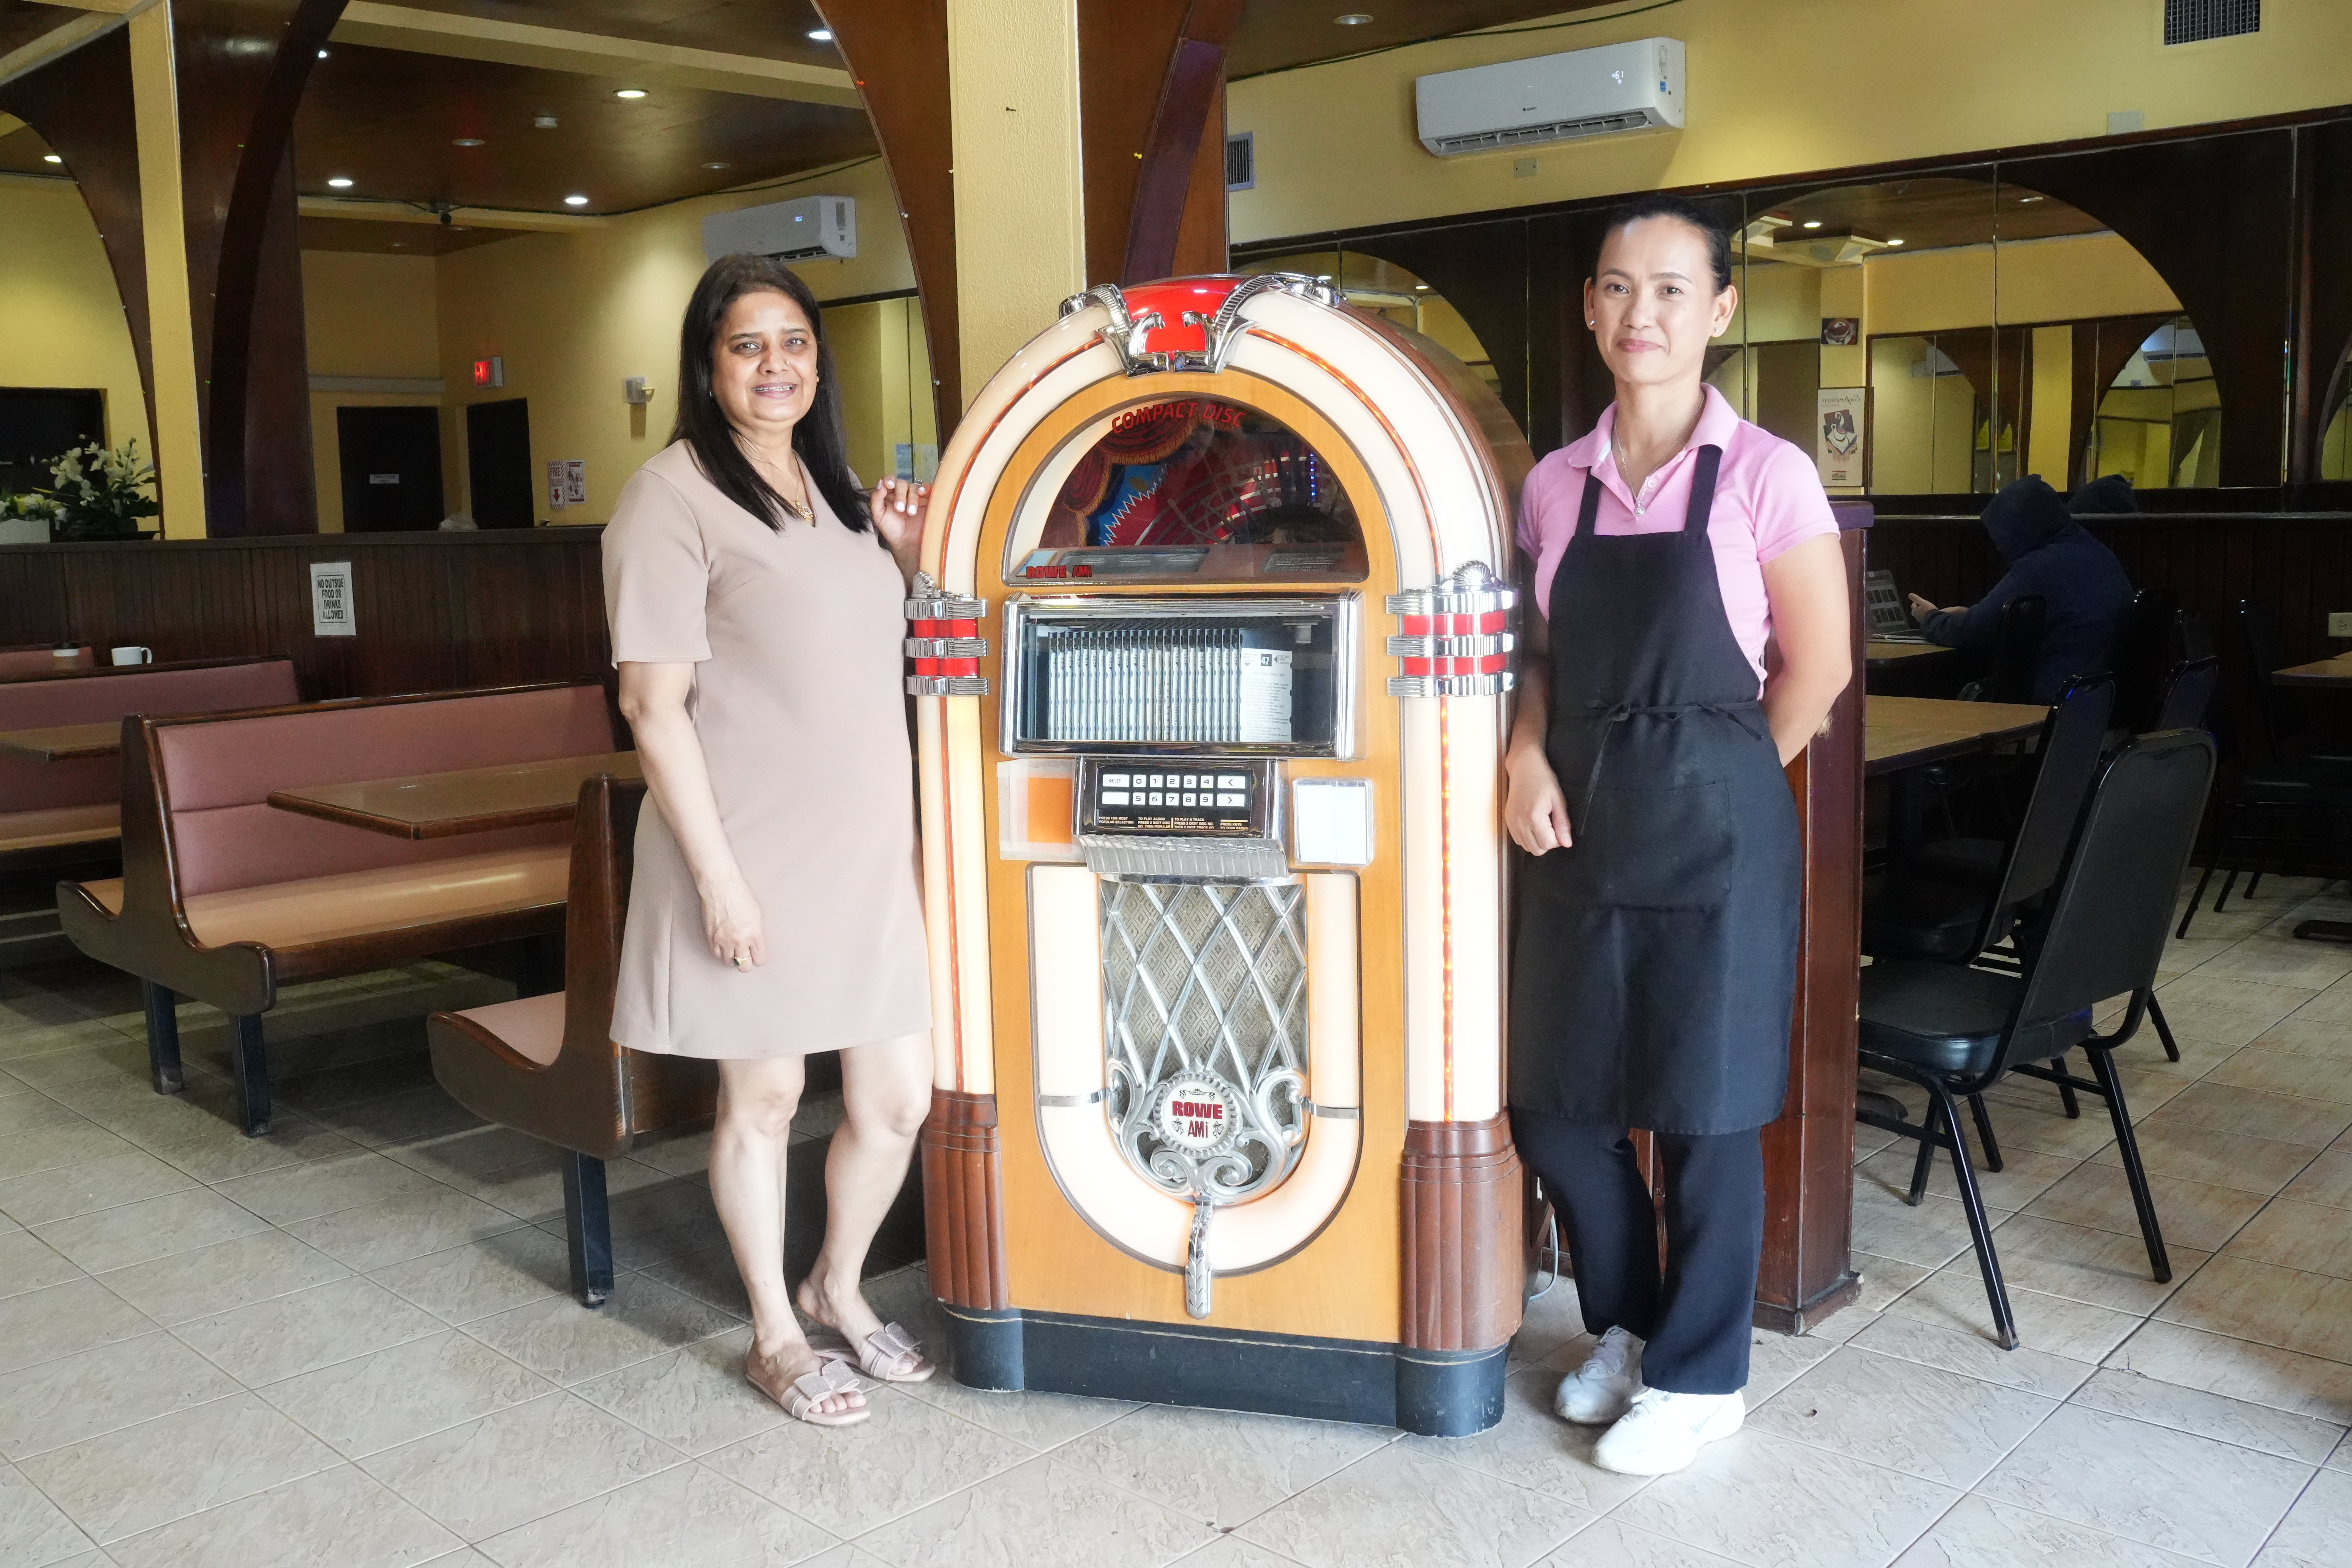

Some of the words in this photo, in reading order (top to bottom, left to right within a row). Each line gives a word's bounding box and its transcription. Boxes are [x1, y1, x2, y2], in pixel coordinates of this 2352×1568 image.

[1615, 71, 1623, 79] 61
[1112, 402, 1198, 434] COMPACT
[1202, 404, 1246, 427] DISC
[550, 467, 561, 477] FIRE
[1026, 565, 1067, 579] ROWE
[318, 579, 324, 588] NO
[325, 579, 343, 588] OUTSIDE
[322, 589, 334, 599] FOOD
[335, 589, 341, 598] OR
[324, 600, 341, 609] DRINKS
[323, 610, 343, 619] ALLOWED
[1172, 1101, 1222, 1119] ROWE
